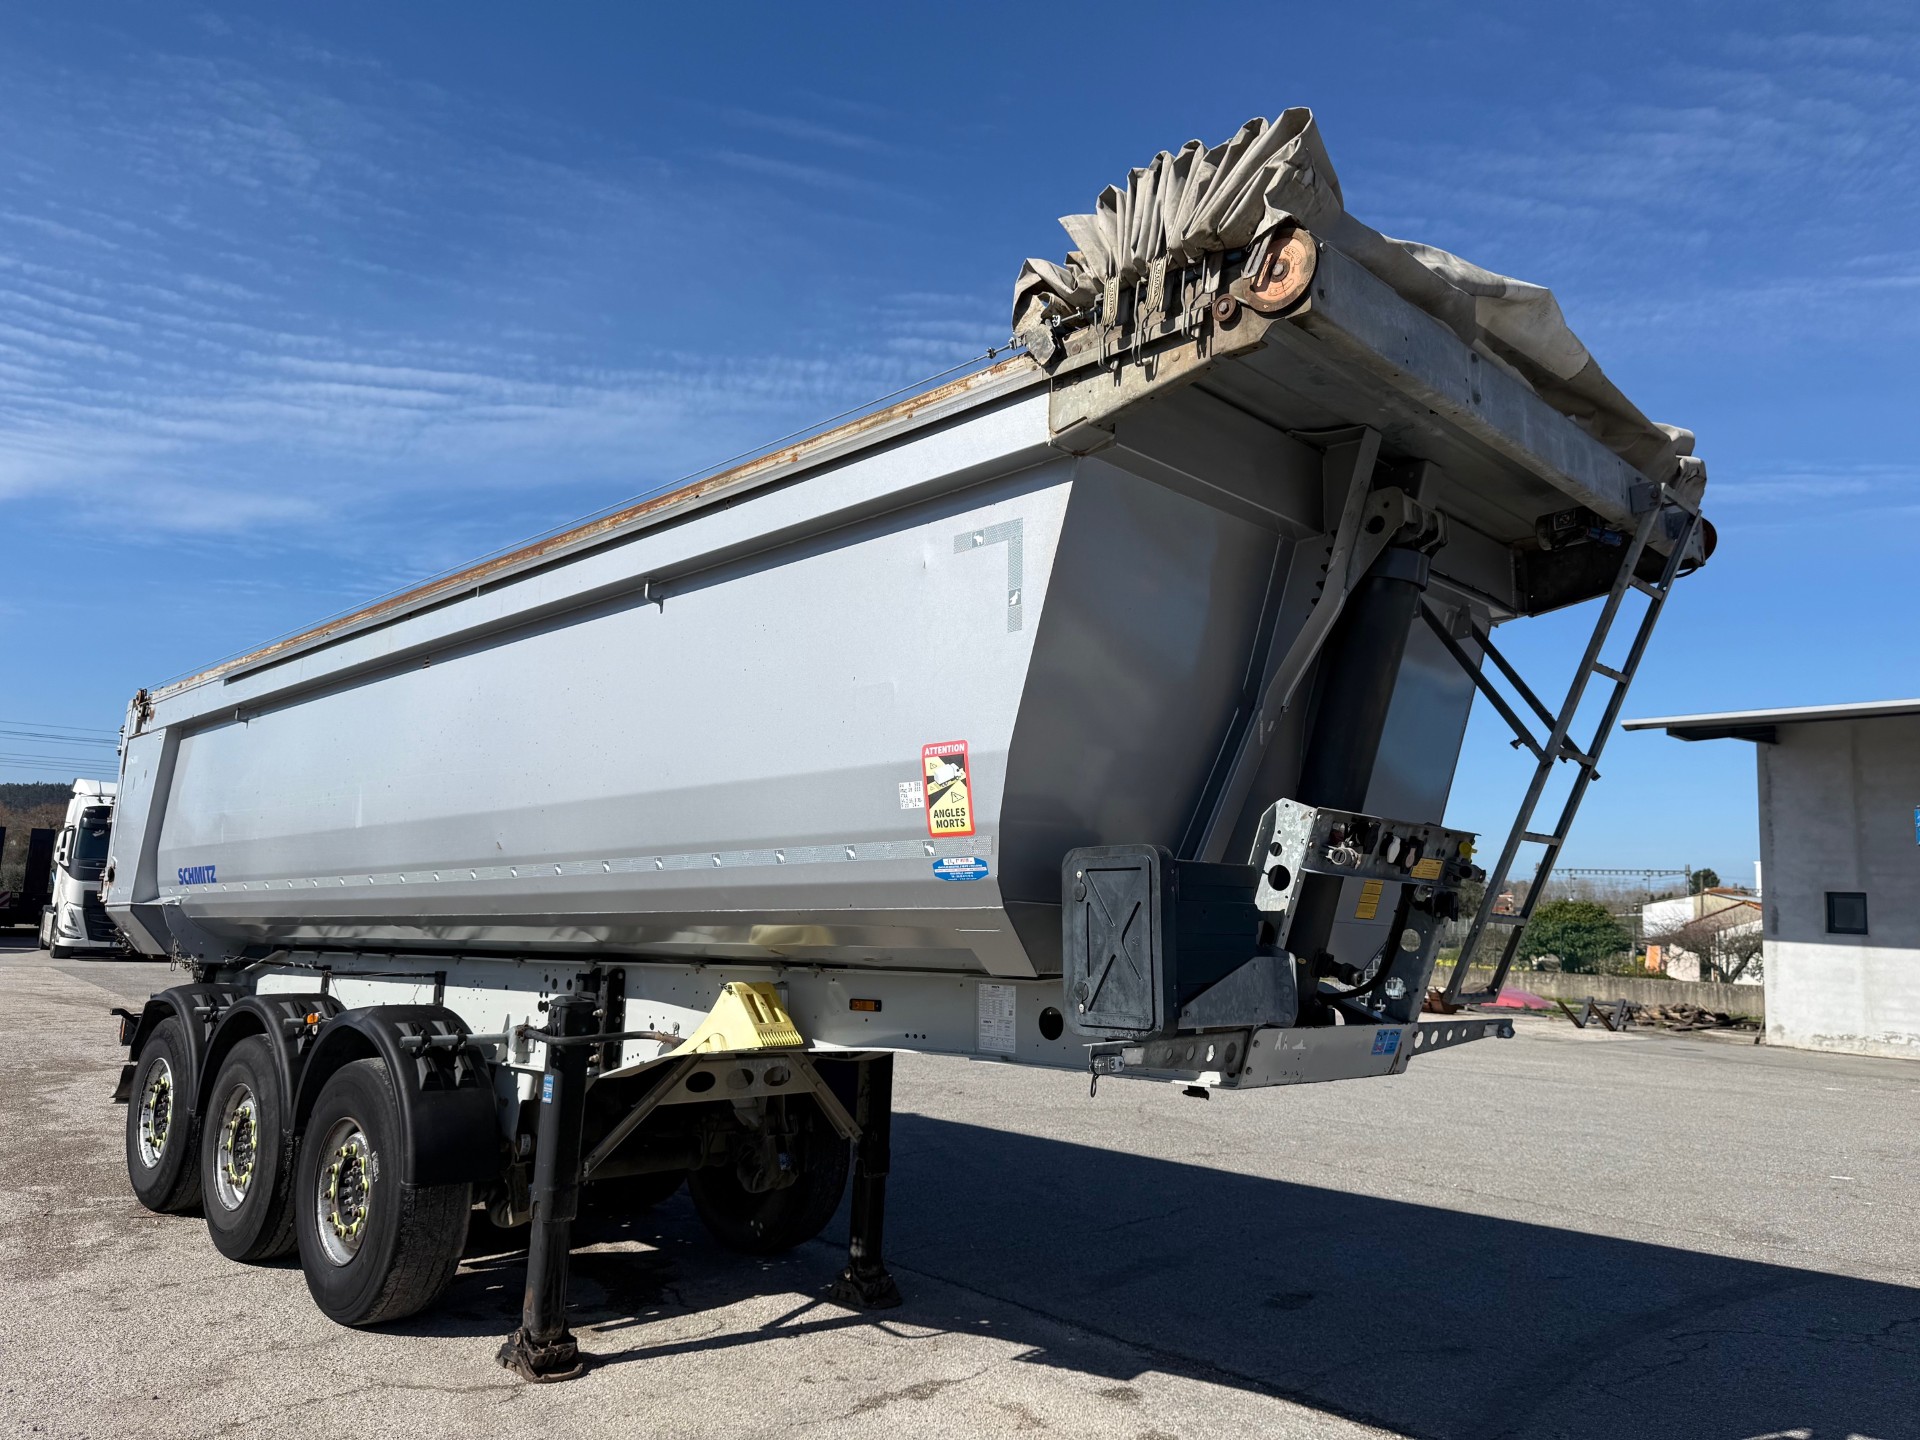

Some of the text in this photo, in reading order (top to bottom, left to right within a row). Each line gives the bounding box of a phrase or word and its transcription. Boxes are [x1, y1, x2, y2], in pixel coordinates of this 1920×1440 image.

[924, 743, 965, 756] ATTENTION
[933, 807, 966, 818] ANGLES
[936, 818, 966, 829] MORTS
[178, 865, 217, 885] SCHMITZ
